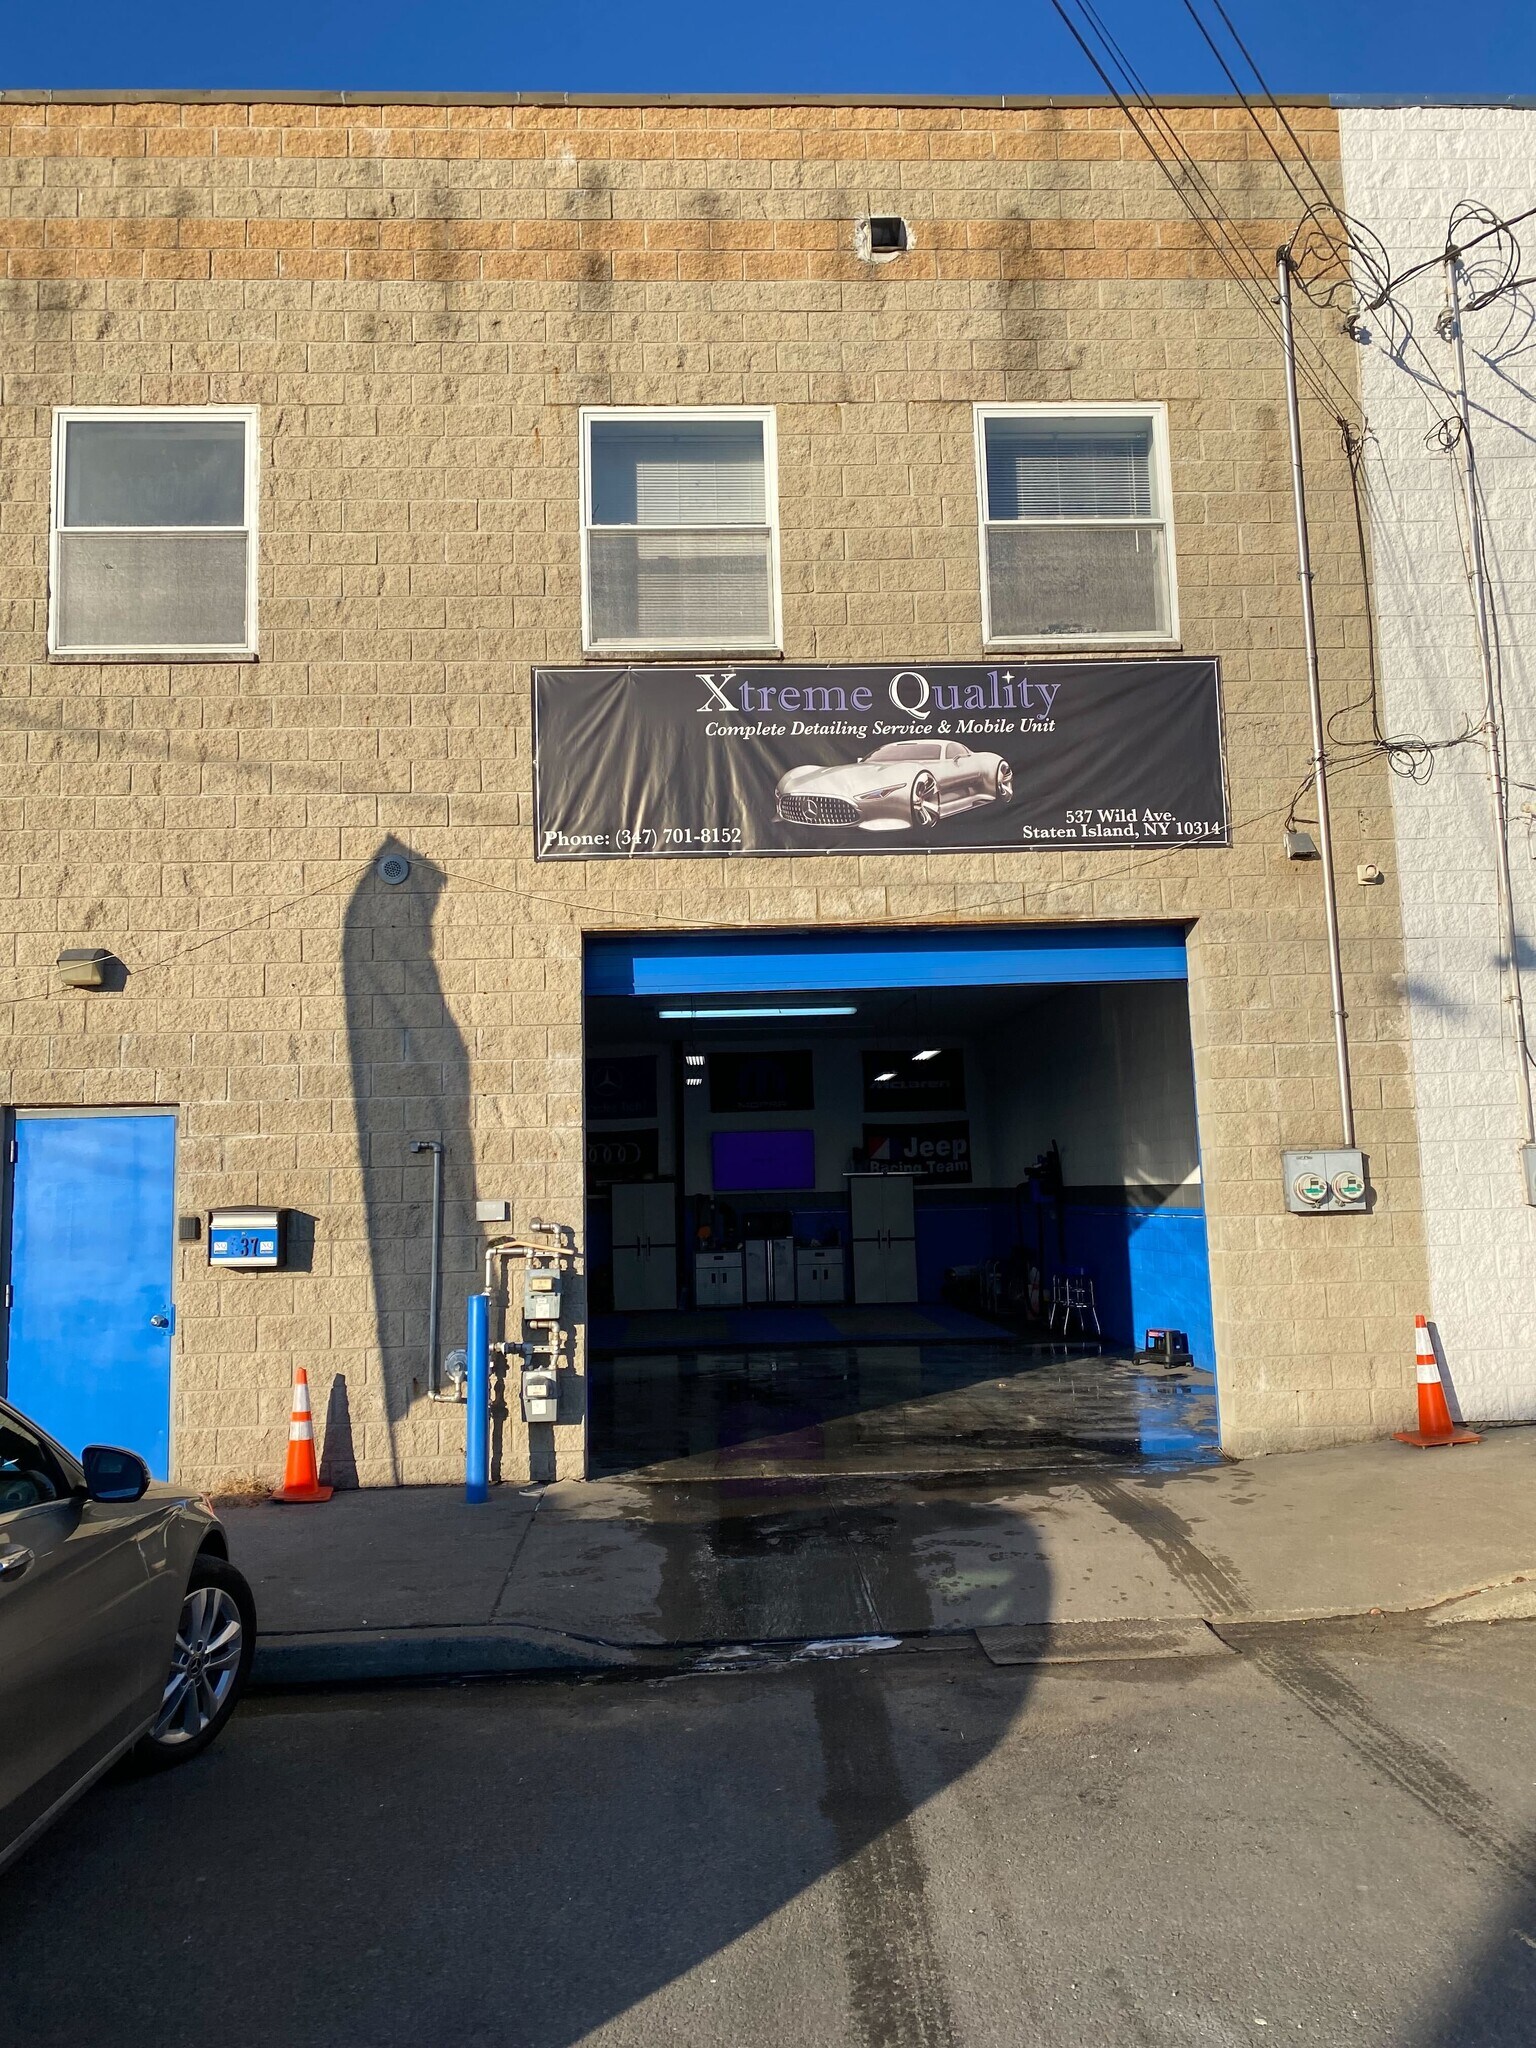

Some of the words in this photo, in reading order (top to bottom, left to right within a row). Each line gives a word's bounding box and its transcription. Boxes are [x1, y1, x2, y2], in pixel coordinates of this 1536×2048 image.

[695, 673, 873, 713] Xtreme
[888, 670, 1062, 721] Quality
[705, 721, 786, 740] Complete
[790, 720, 868, 739] Detailing
[872, 719, 933, 736] Service
[937, 719, 951, 734] &
[955, 718, 1015, 734] Mobile
[1020, 717, 1056, 733] Unit
[1065, 809, 1093, 824] 537
[1097, 807, 1139, 823] Wild
[1141, 807, 1176, 823] Ave.
[543, 830, 610, 848] Phone:
[615, 827, 658, 850] (347)
[663, 826, 742, 845] 701-8152
[1022, 825, 1077, 840] Staten
[1081, 823, 1141, 841] Island,
[1143, 822, 1171, 837] NY
[1175, 821, 1222, 837] 10314
[903, 1136, 968, 1160] Jeep
[926, 1159, 969, 1174] Team
